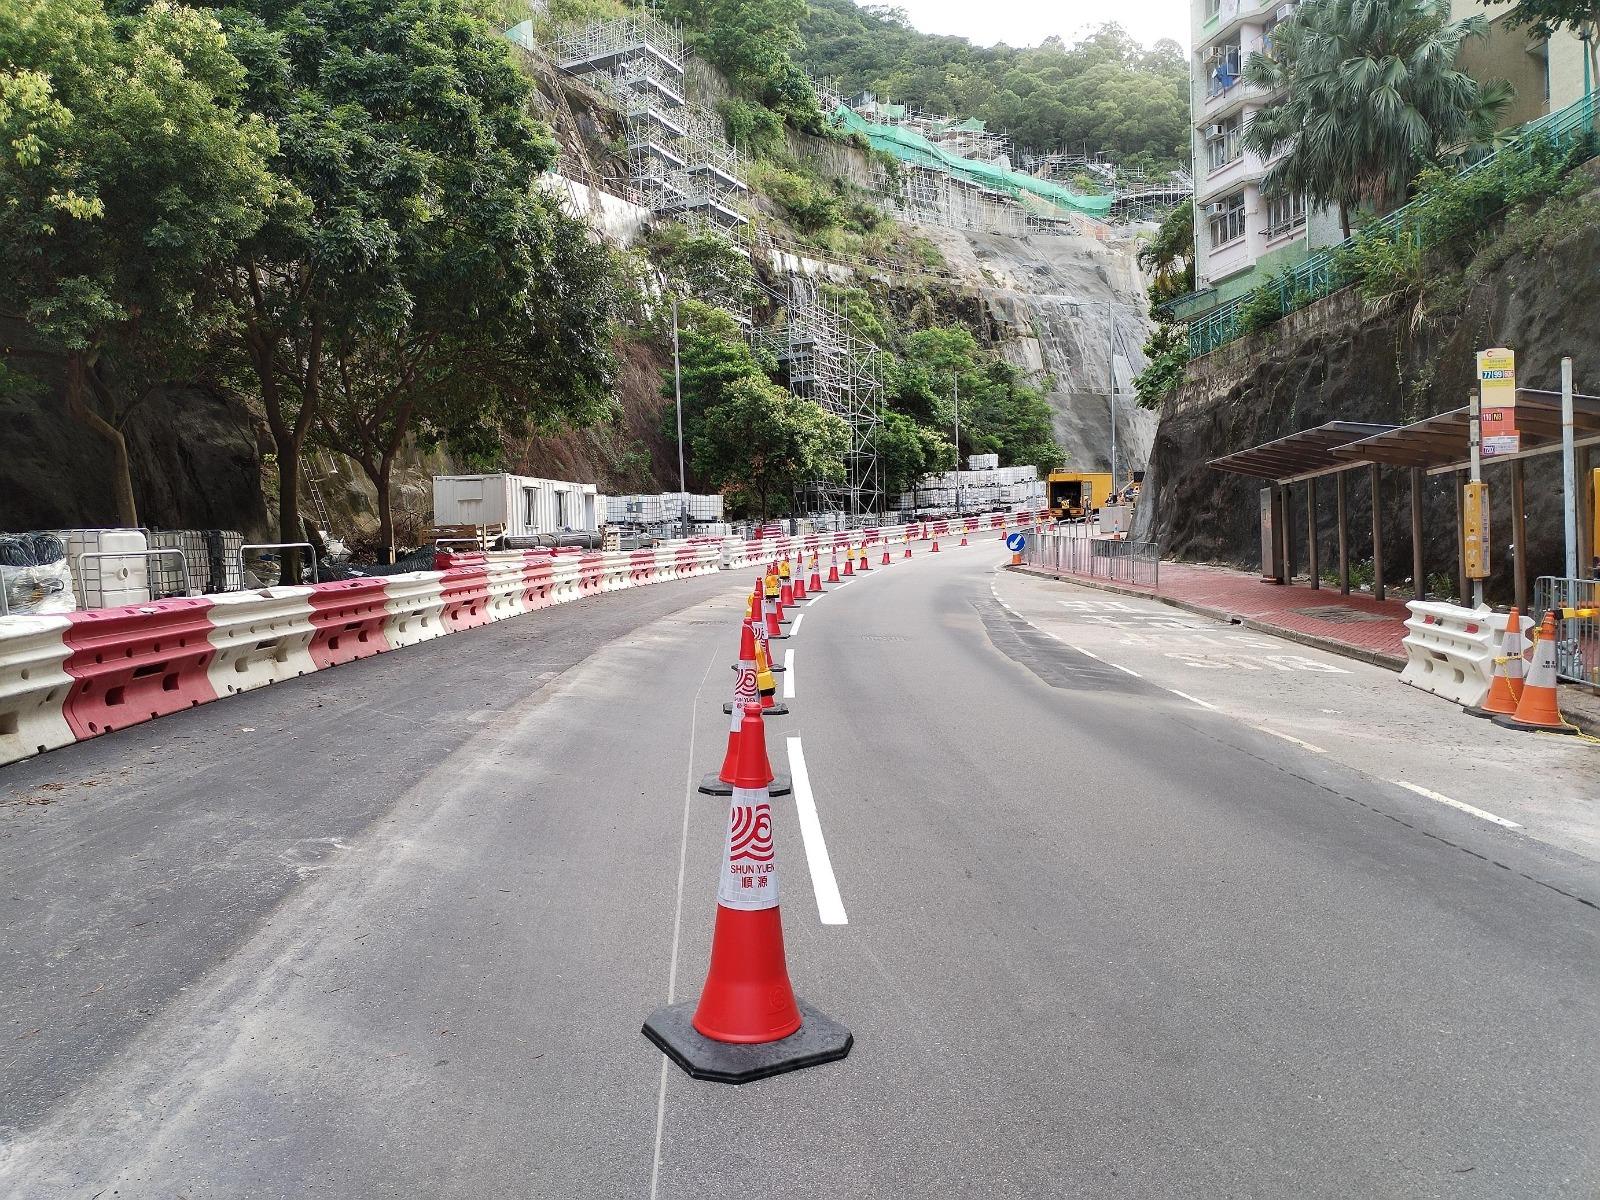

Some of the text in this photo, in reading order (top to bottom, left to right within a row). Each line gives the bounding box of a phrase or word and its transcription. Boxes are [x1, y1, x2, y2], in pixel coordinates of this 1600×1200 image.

[1483, 371, 1492, 379] 77
[730, 864, 755, 874] SHUN
[741, 876, 768, 888] 順源
